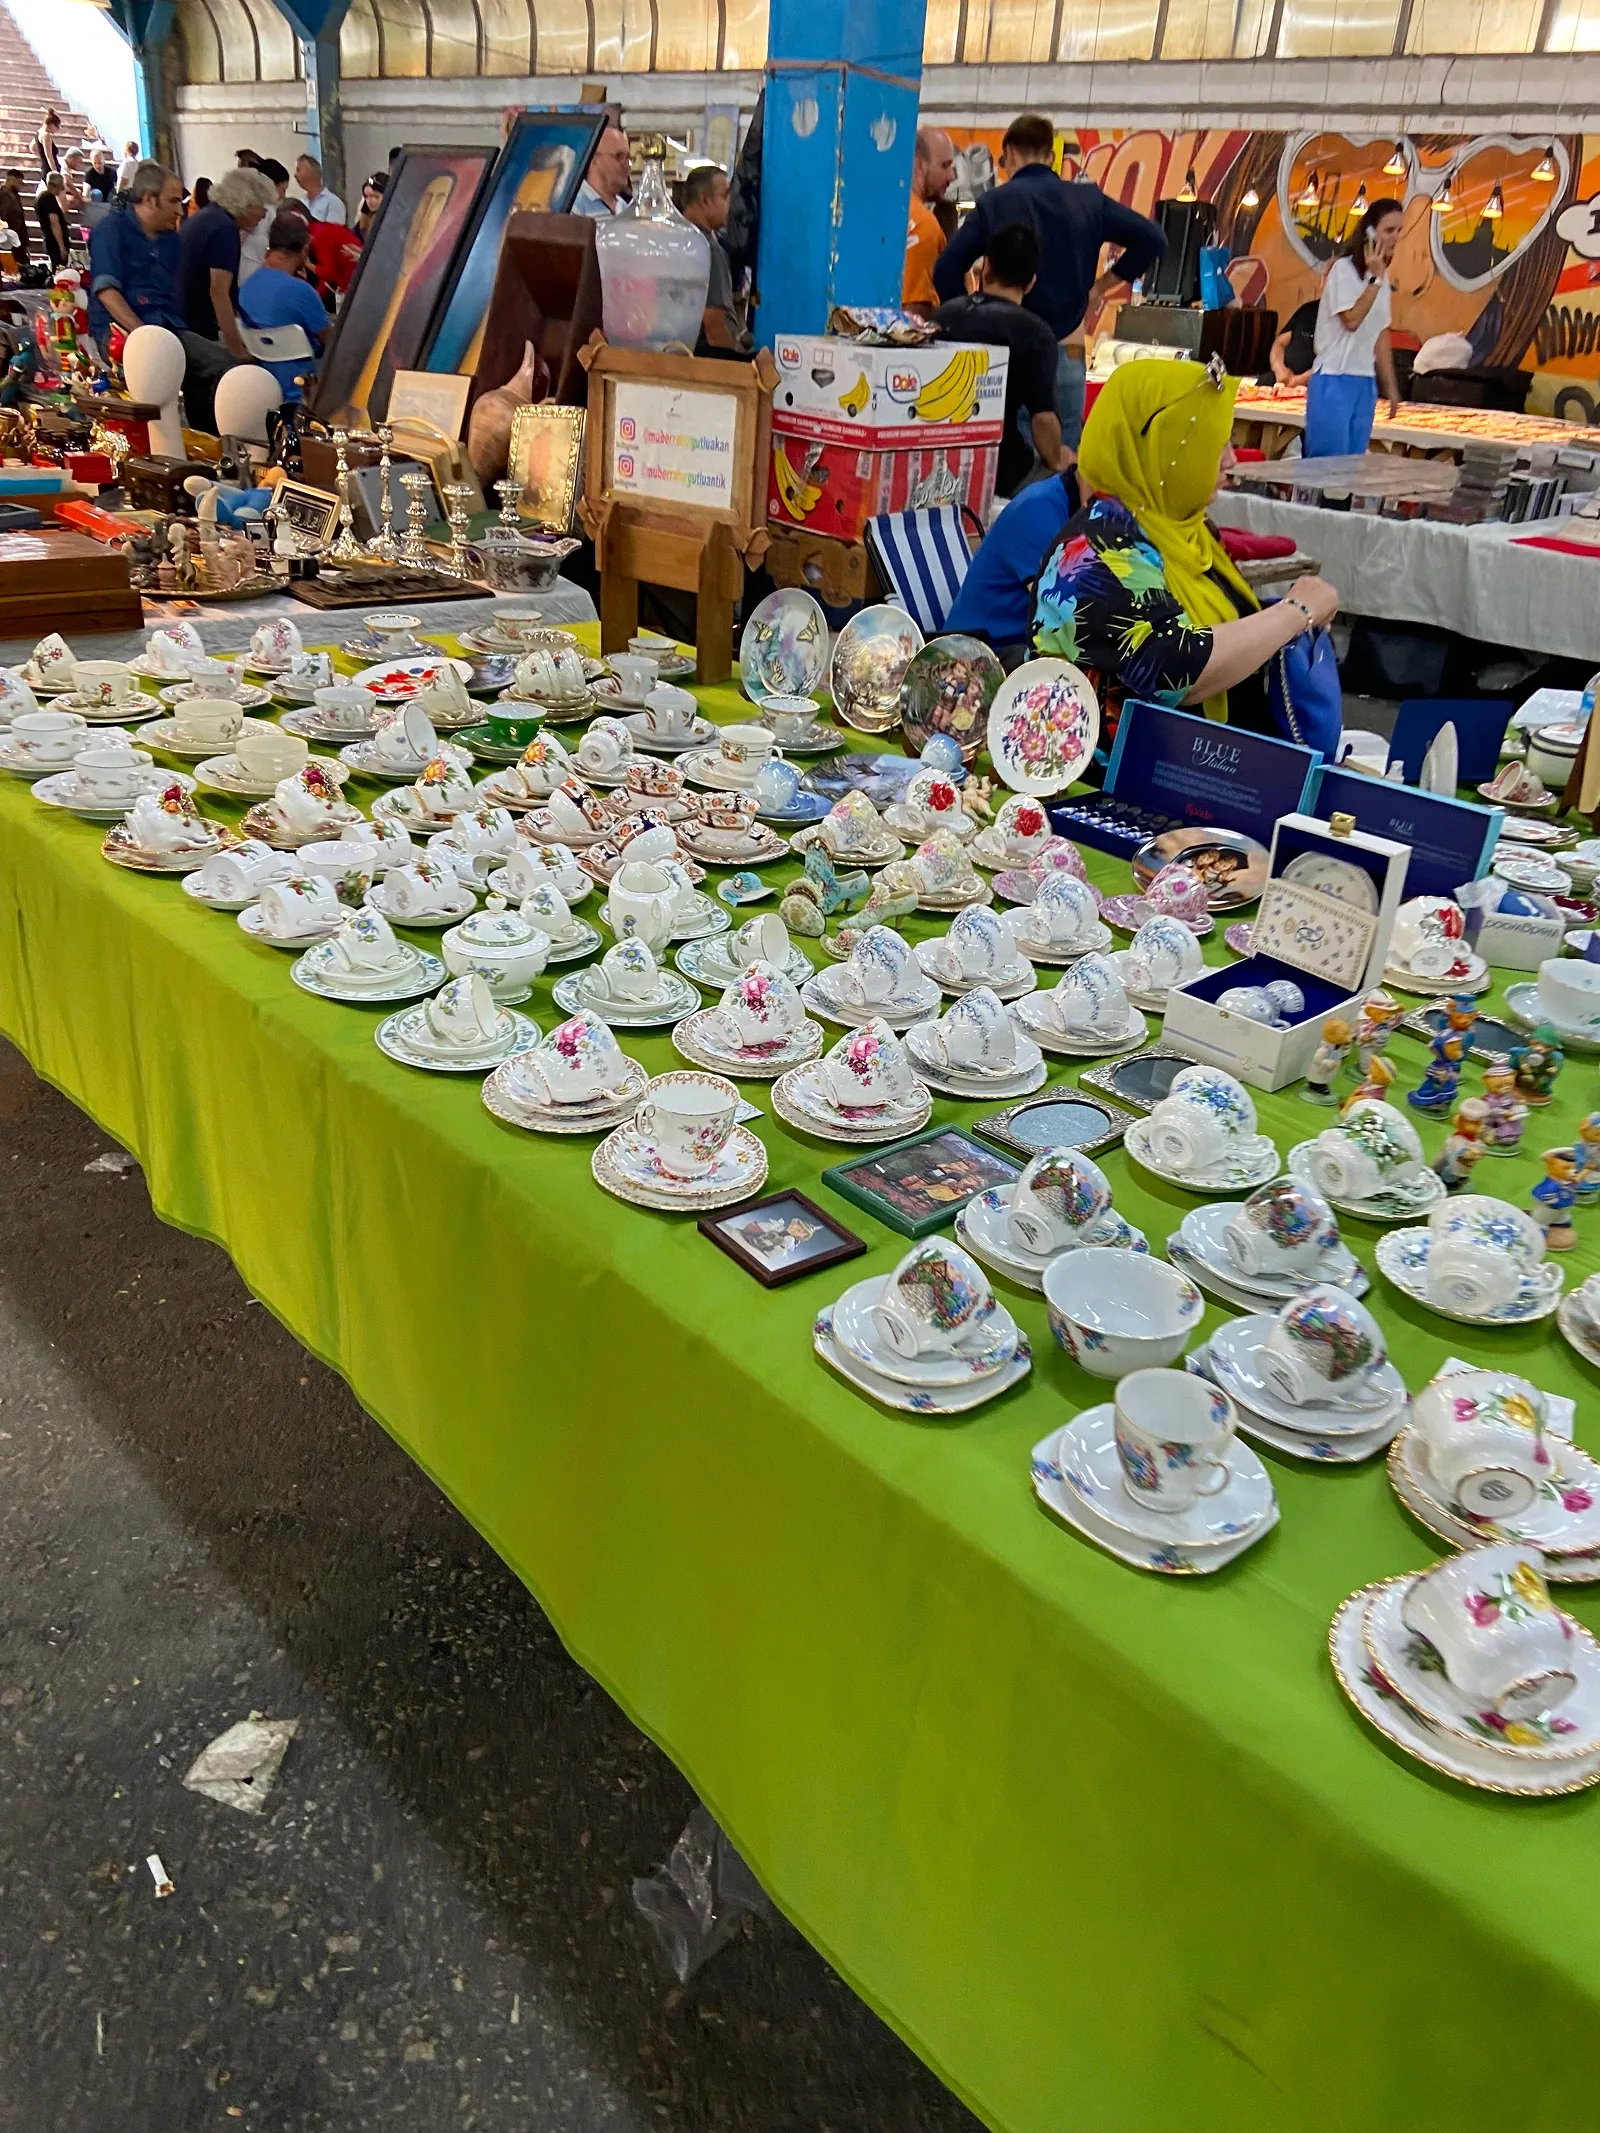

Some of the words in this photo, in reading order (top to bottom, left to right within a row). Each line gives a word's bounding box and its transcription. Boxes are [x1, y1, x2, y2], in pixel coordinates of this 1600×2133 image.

[783, 348, 800, 361] Dole
[893, 374, 917, 389] Dole
[976, 375, 1003, 387] PREMIUM
[1192, 737, 1241, 763] BLUE
[1192, 751, 1237, 774] Italian
